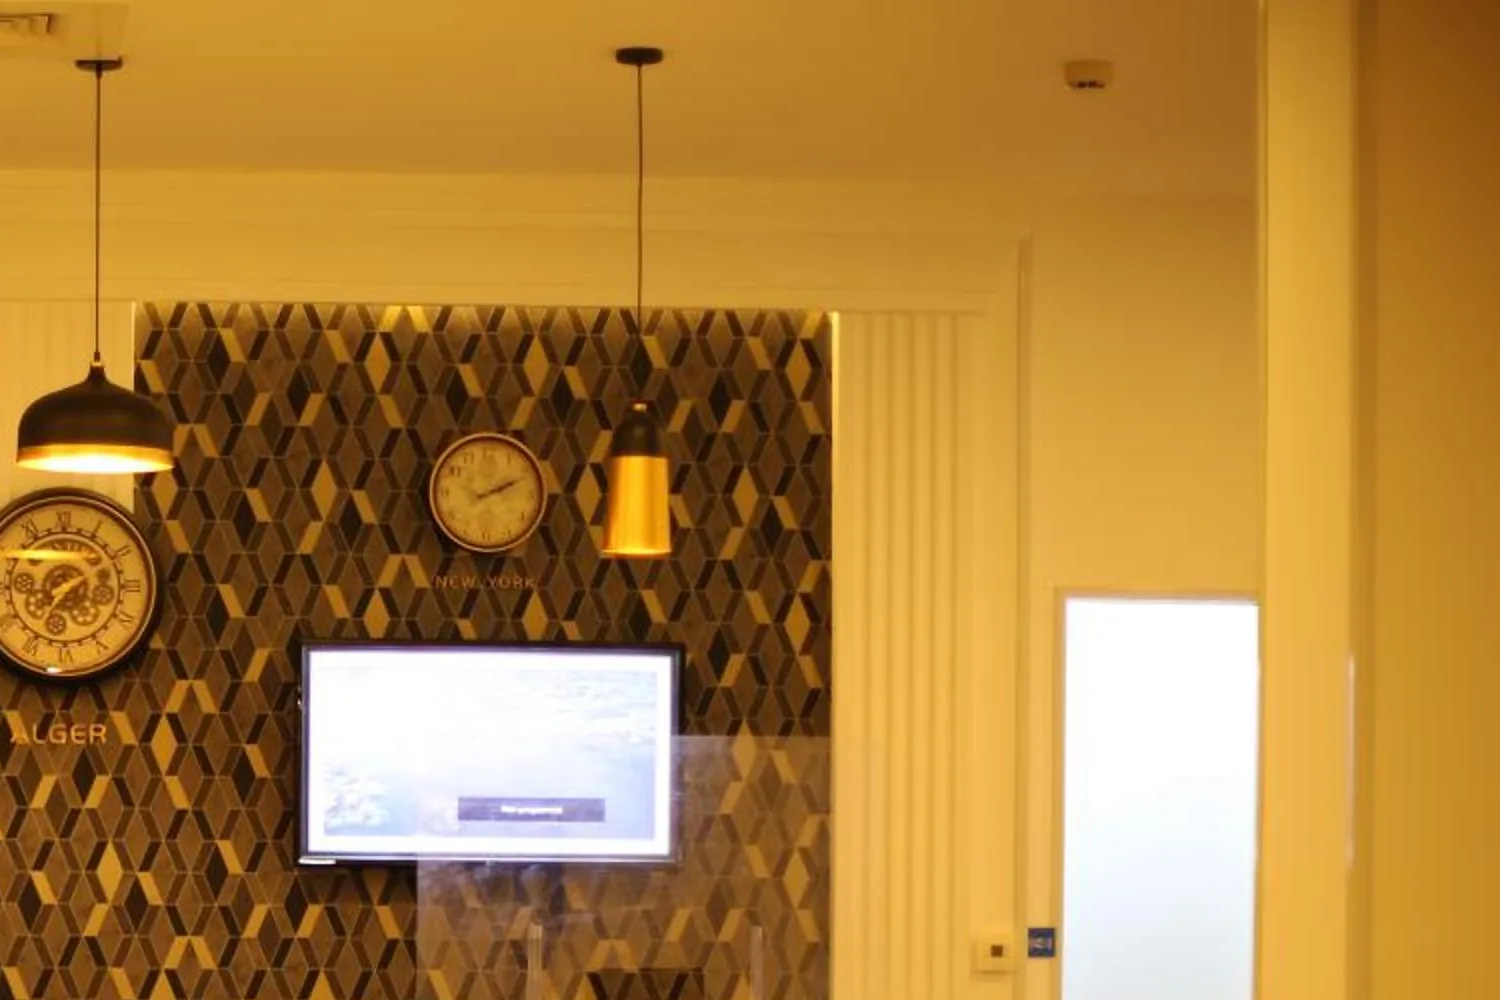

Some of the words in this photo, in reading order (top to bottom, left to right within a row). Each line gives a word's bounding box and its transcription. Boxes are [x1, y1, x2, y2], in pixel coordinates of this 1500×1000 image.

[435, 575, 476, 589] NEW
[488, 575, 535, 589] YORK
[10, 724, 107, 745] ALGER
